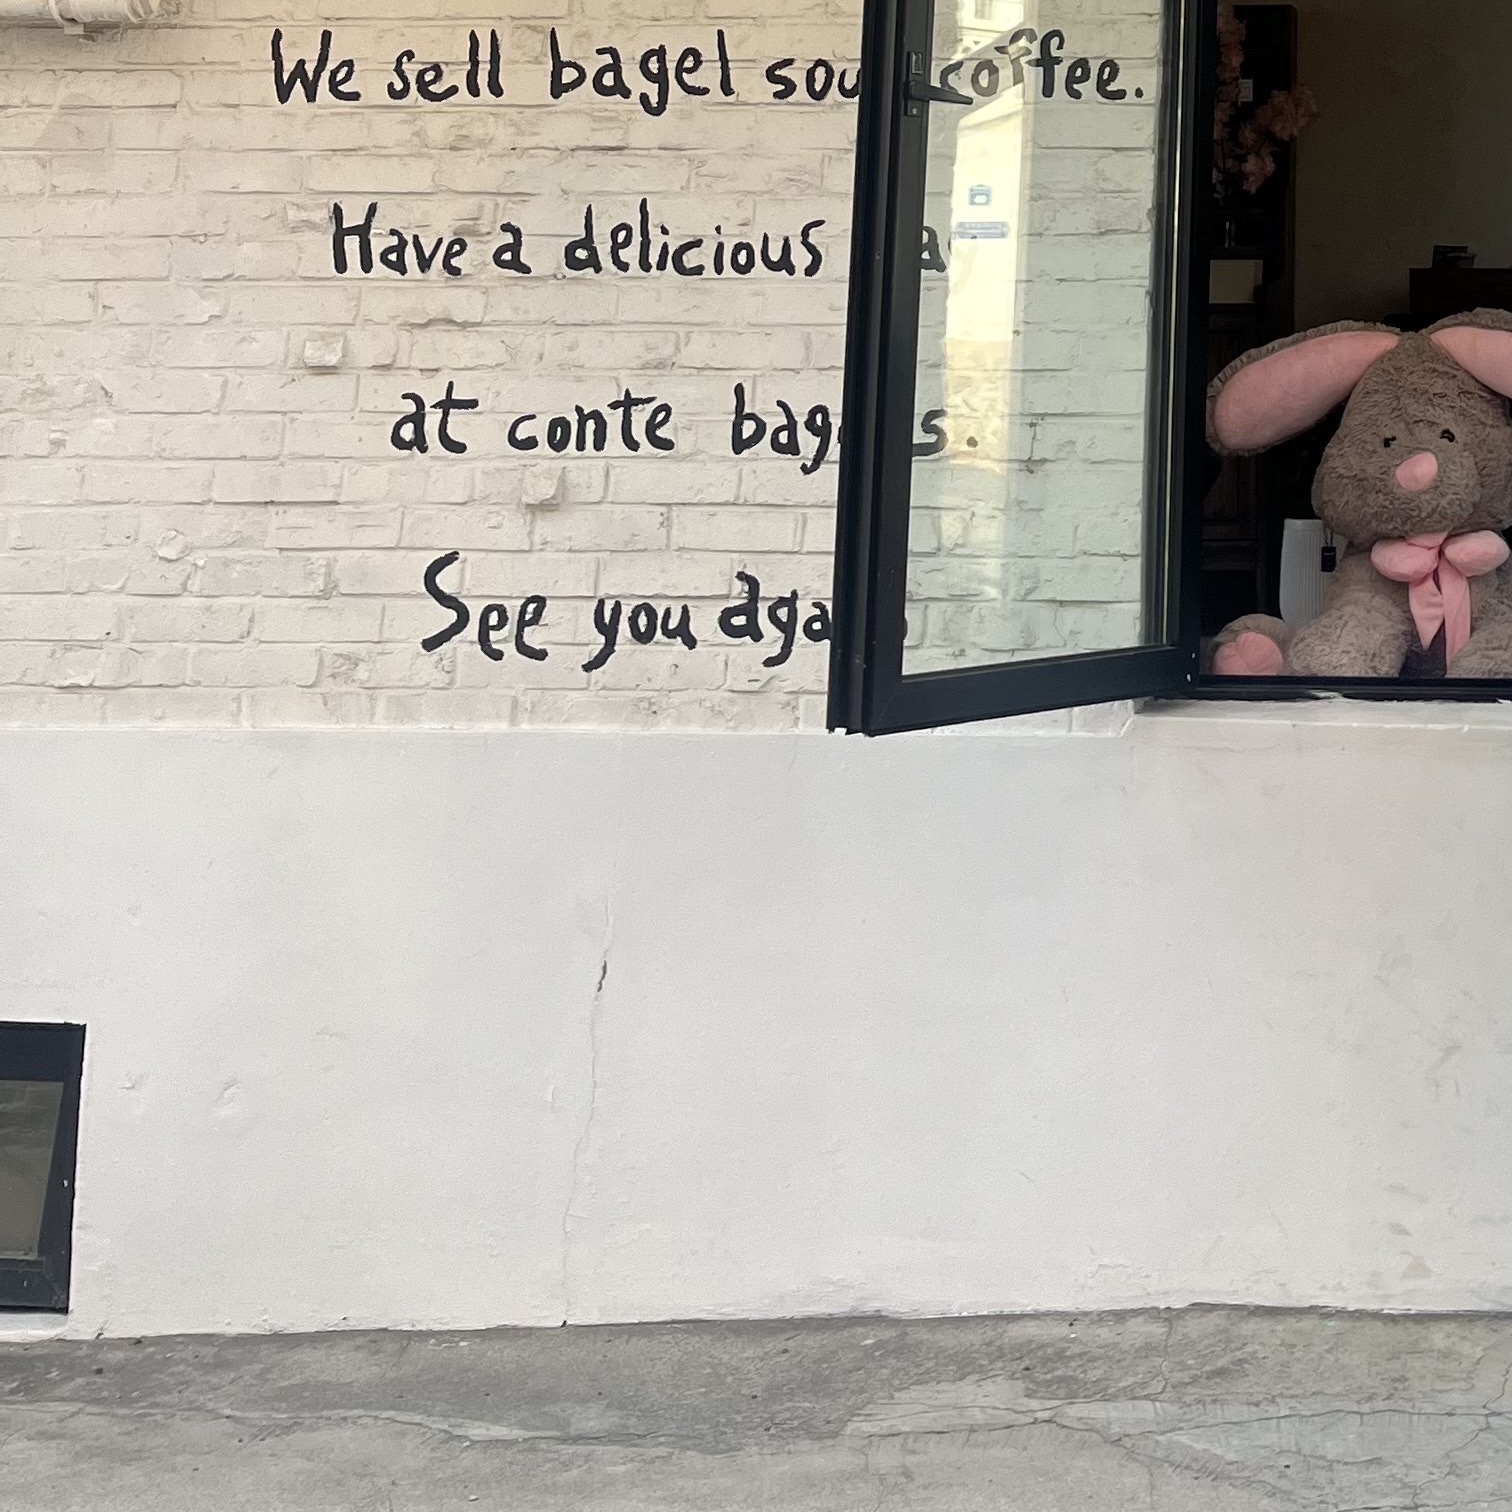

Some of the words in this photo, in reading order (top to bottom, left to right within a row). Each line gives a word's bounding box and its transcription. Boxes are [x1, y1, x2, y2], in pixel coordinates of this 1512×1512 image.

[271, 28, 361, 105] We
[387, 28, 504, 103] sell
[549, 26, 736, 117] bagel
[332, 202, 468, 277] Have
[492, 221, 532, 275] a
[564, 197, 826, 278] delicious
[390, 380, 479, 454] at
[507, 388, 675, 453] conte
[731, 382, 979, 476] bags.
[421, 550, 549, 662] See
[581, 592, 698, 673] you
